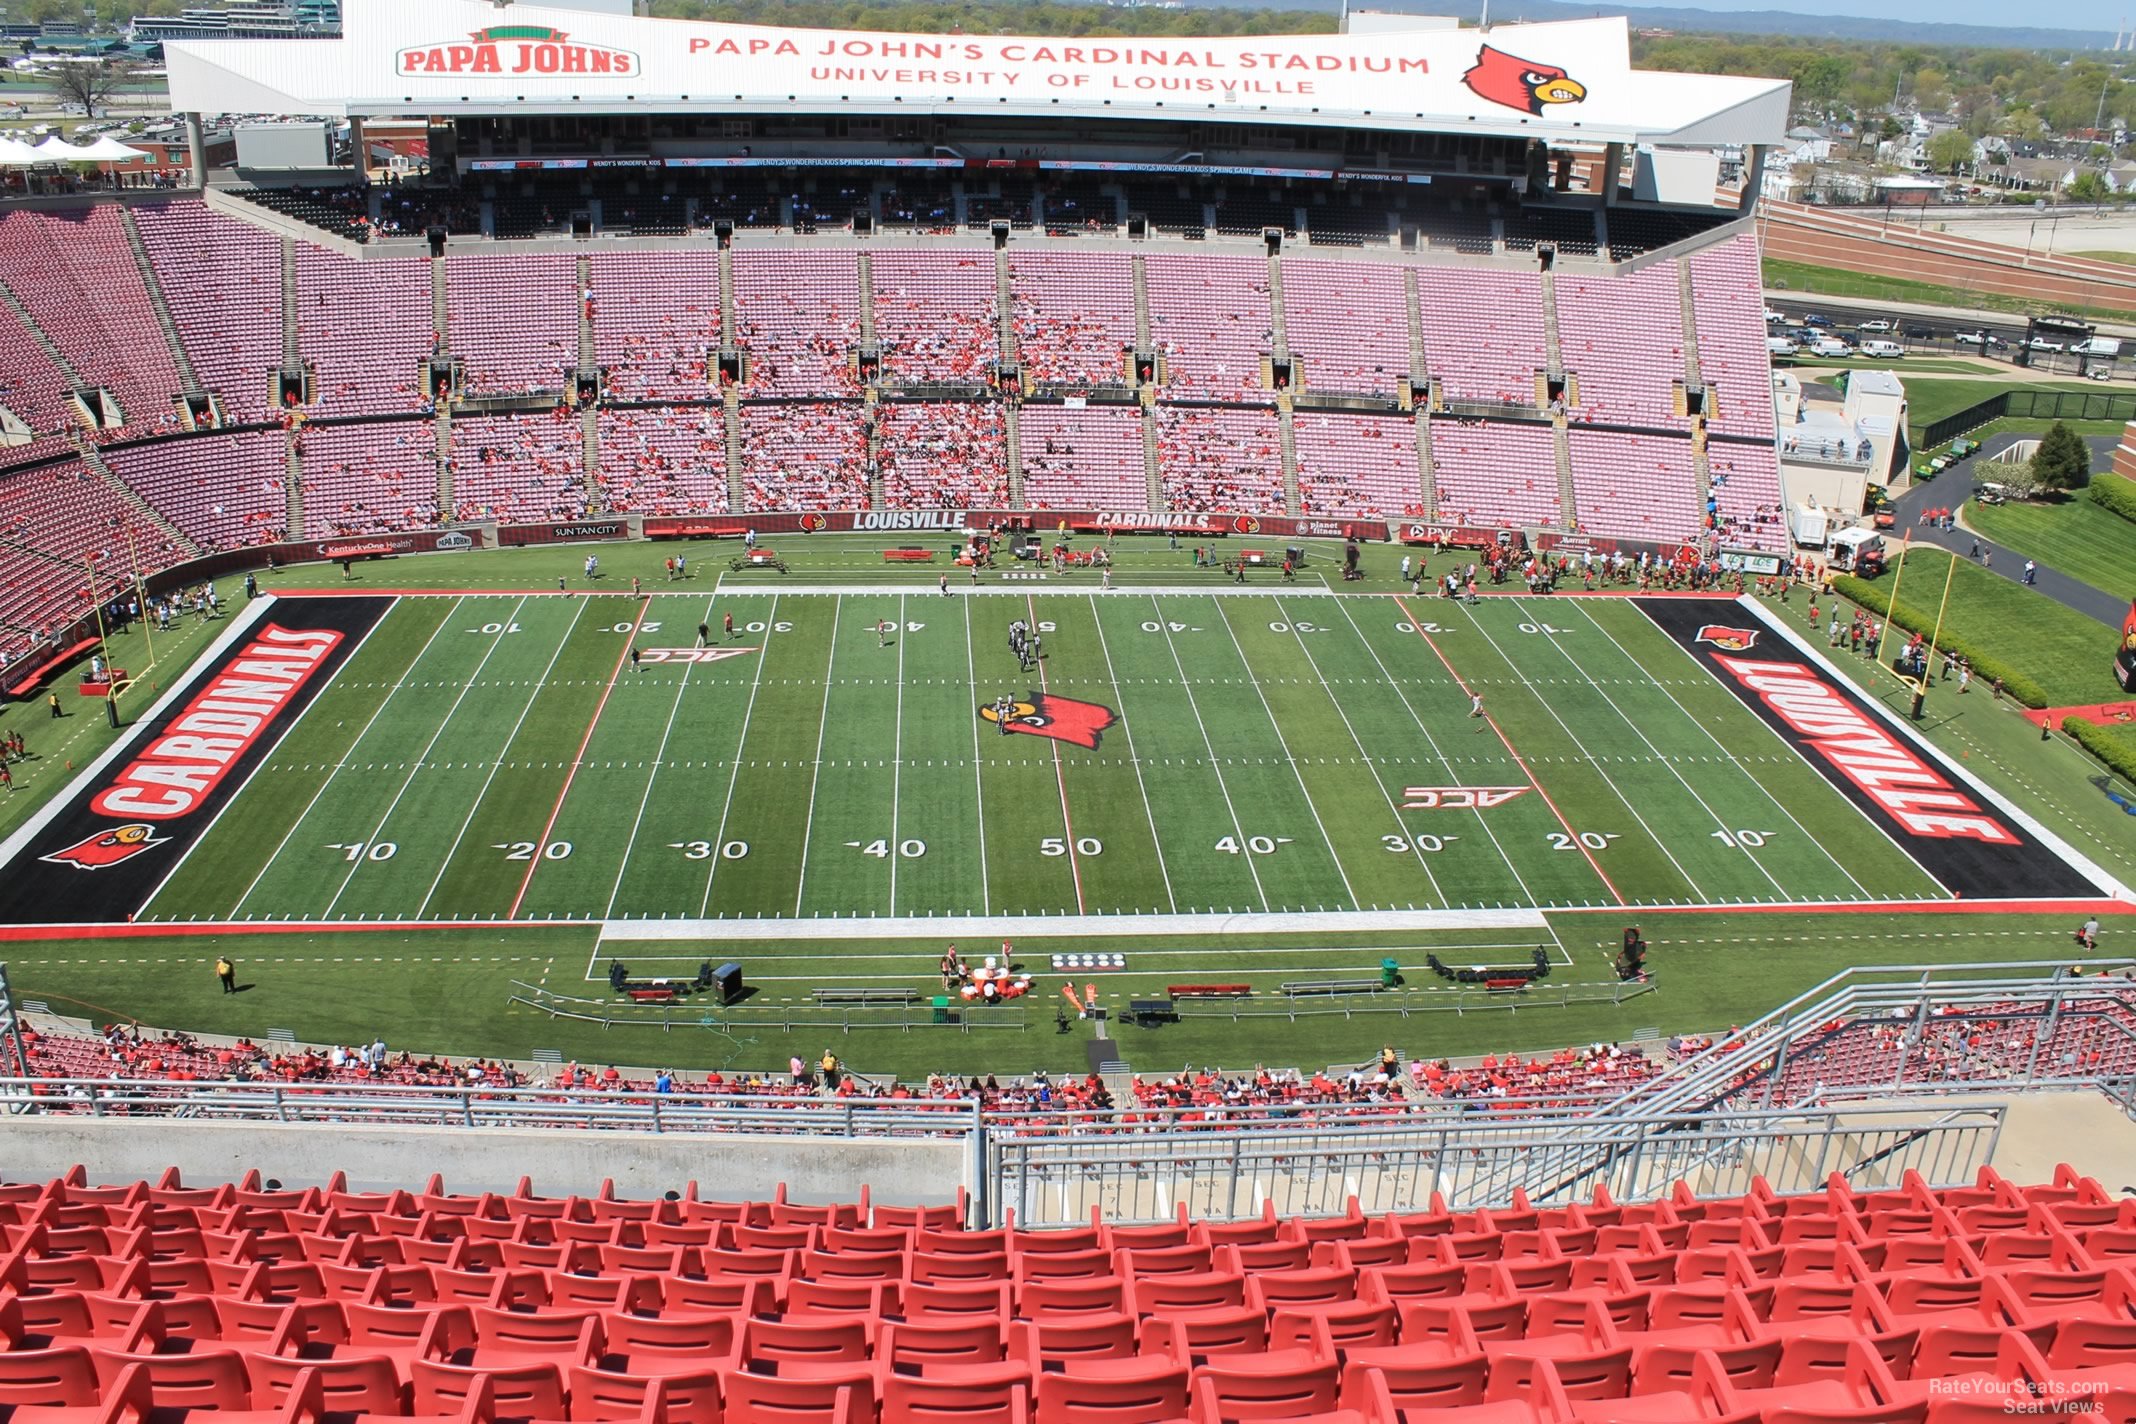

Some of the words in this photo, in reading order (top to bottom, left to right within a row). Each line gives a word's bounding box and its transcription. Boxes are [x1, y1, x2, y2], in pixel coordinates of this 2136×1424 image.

[403, 44, 502, 73] PAPA
[689, 37, 800, 55] PAPA
[818, 39, 984, 60] JOHN'S
[999, 45, 1225, 68] CARDINAL
[1239, 52, 1430, 74] STADIUM
[810, 67, 1021, 86] UNIVERSITY
[1047, 73, 1091, 88] OF
[1112, 75, 1315, 95] LOUISVILLE
[853, 511, 967, 529] LOUISVILLE
[1096, 512, 1210, 529] CARDINALS
[555, 527, 575, 537] SUN
[576, 526, 597, 535] TAN
[597, 525, 619, 535] CITY
[1427, 527, 1459, 538] PNC
[386, 540, 411, 549] Health
[481, 622, 523, 634] 10
[612, 622, 662, 633] 20
[745, 621, 793, 633] 30
[1141, 621, 1187, 633] 40
[1269, 621, 1316, 633] 30
[1394, 621, 1443, 634] 20
[1517, 622, 1564, 635] 10
[100, 624, 341, 817] CARDINALS
[1721, 656, 2010, 842] LOUISVILLE
[1400, 786, 1531, 808] ACC
[1040, 837, 1104, 857] 50
[1214, 835, 1277, 856] 40
[1381, 834, 1445, 853] 30
[1546, 831, 1611, 851] 20
[1709, 828, 1767, 849] 10
[343, 841, 398, 862] 10
[505, 840, 574, 861] 20
[684, 840, 749, 860] 30
[863, 838, 927, 859] 40
[1195, 1180, 1220, 1188] SEC
